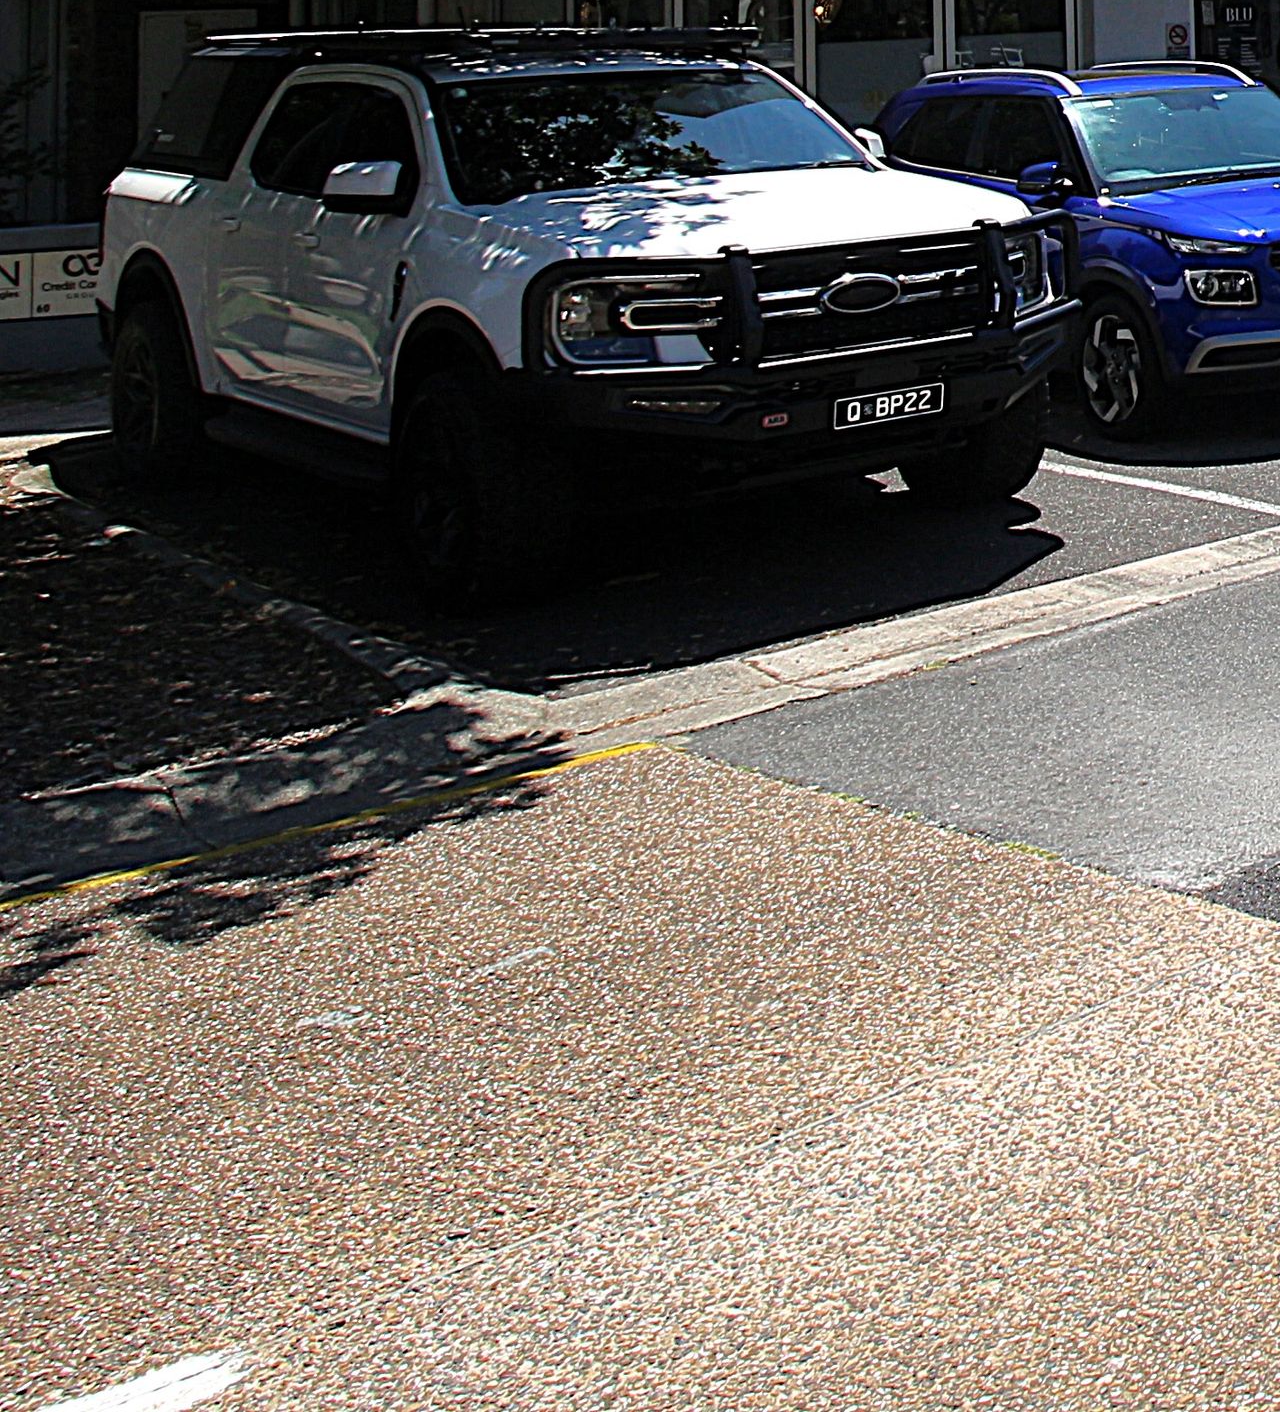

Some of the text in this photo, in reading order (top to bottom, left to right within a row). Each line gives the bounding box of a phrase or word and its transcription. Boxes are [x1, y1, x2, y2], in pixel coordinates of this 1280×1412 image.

[1226, 7, 1253, 22] BLU
[42, 280, 97, 292] Credit Car
[37, 304, 50, 312] 60
[847, 390, 932, 422] Q BP22
